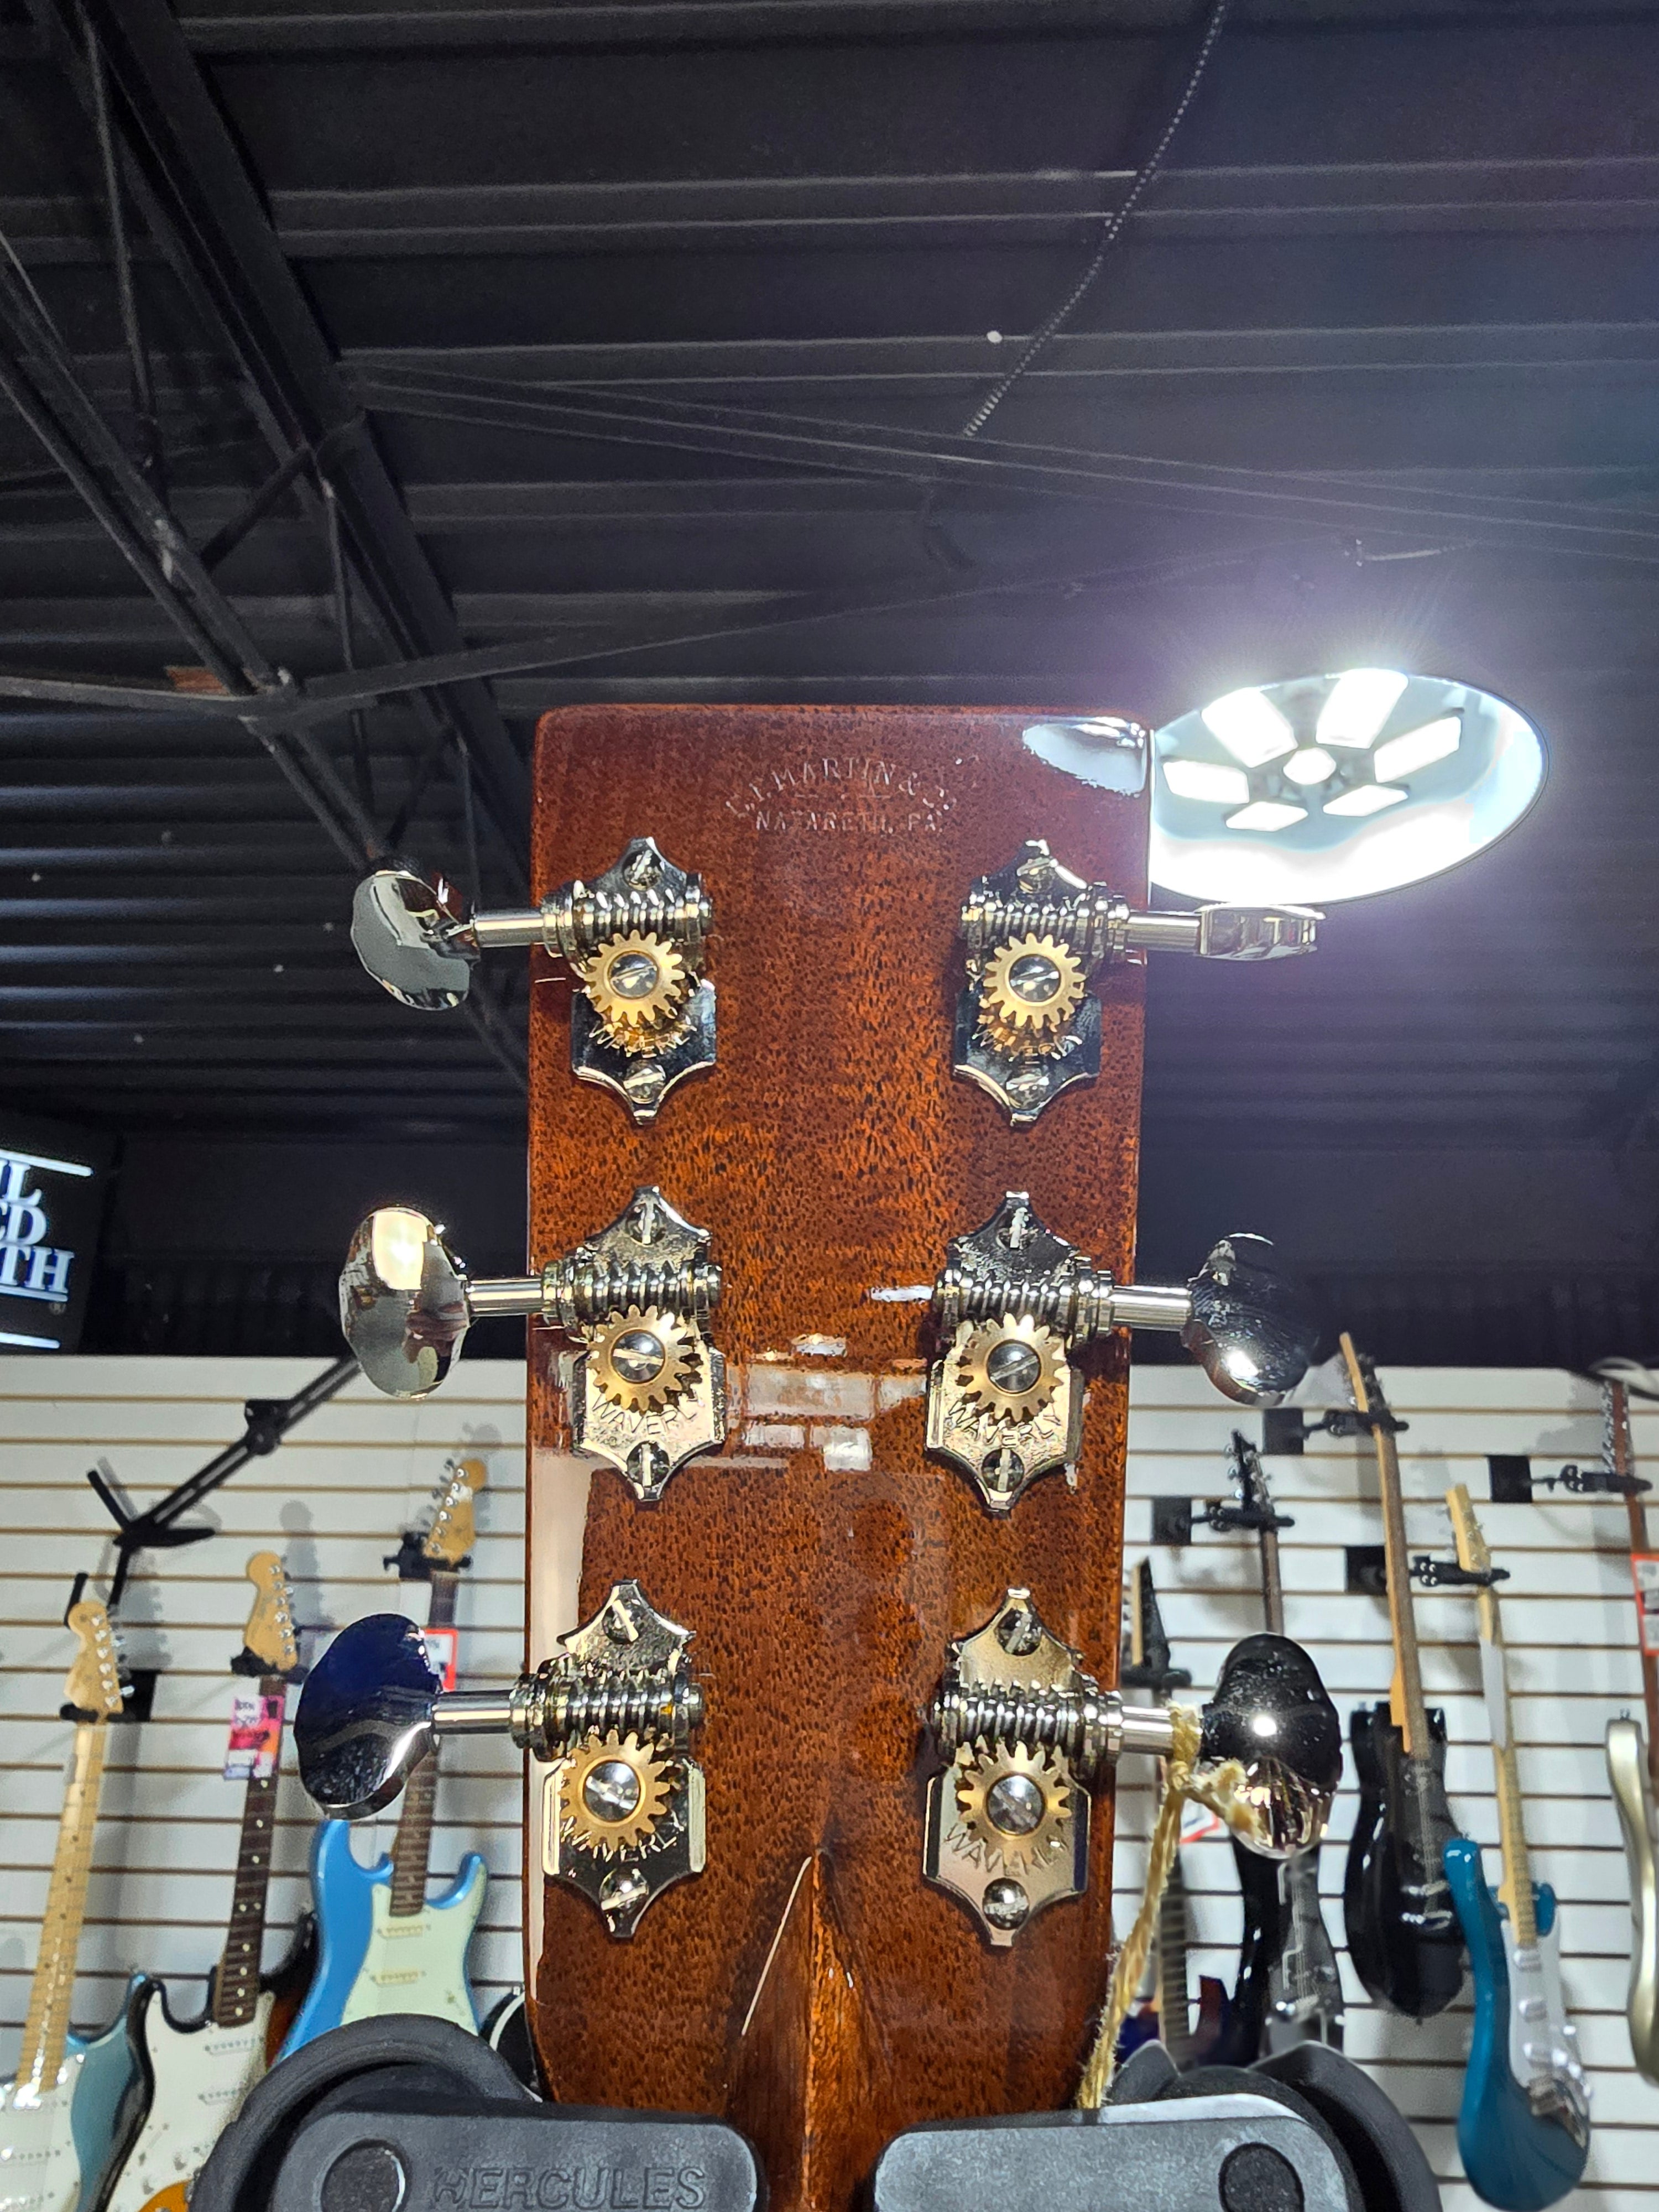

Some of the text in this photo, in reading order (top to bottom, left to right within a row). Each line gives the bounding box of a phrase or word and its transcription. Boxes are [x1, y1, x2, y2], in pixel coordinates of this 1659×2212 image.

[771, 757, 898, 792] MARTIN
[592, 1389, 705, 1436] WAVERLY
[433, 2166, 706, 2210] HERCULES
